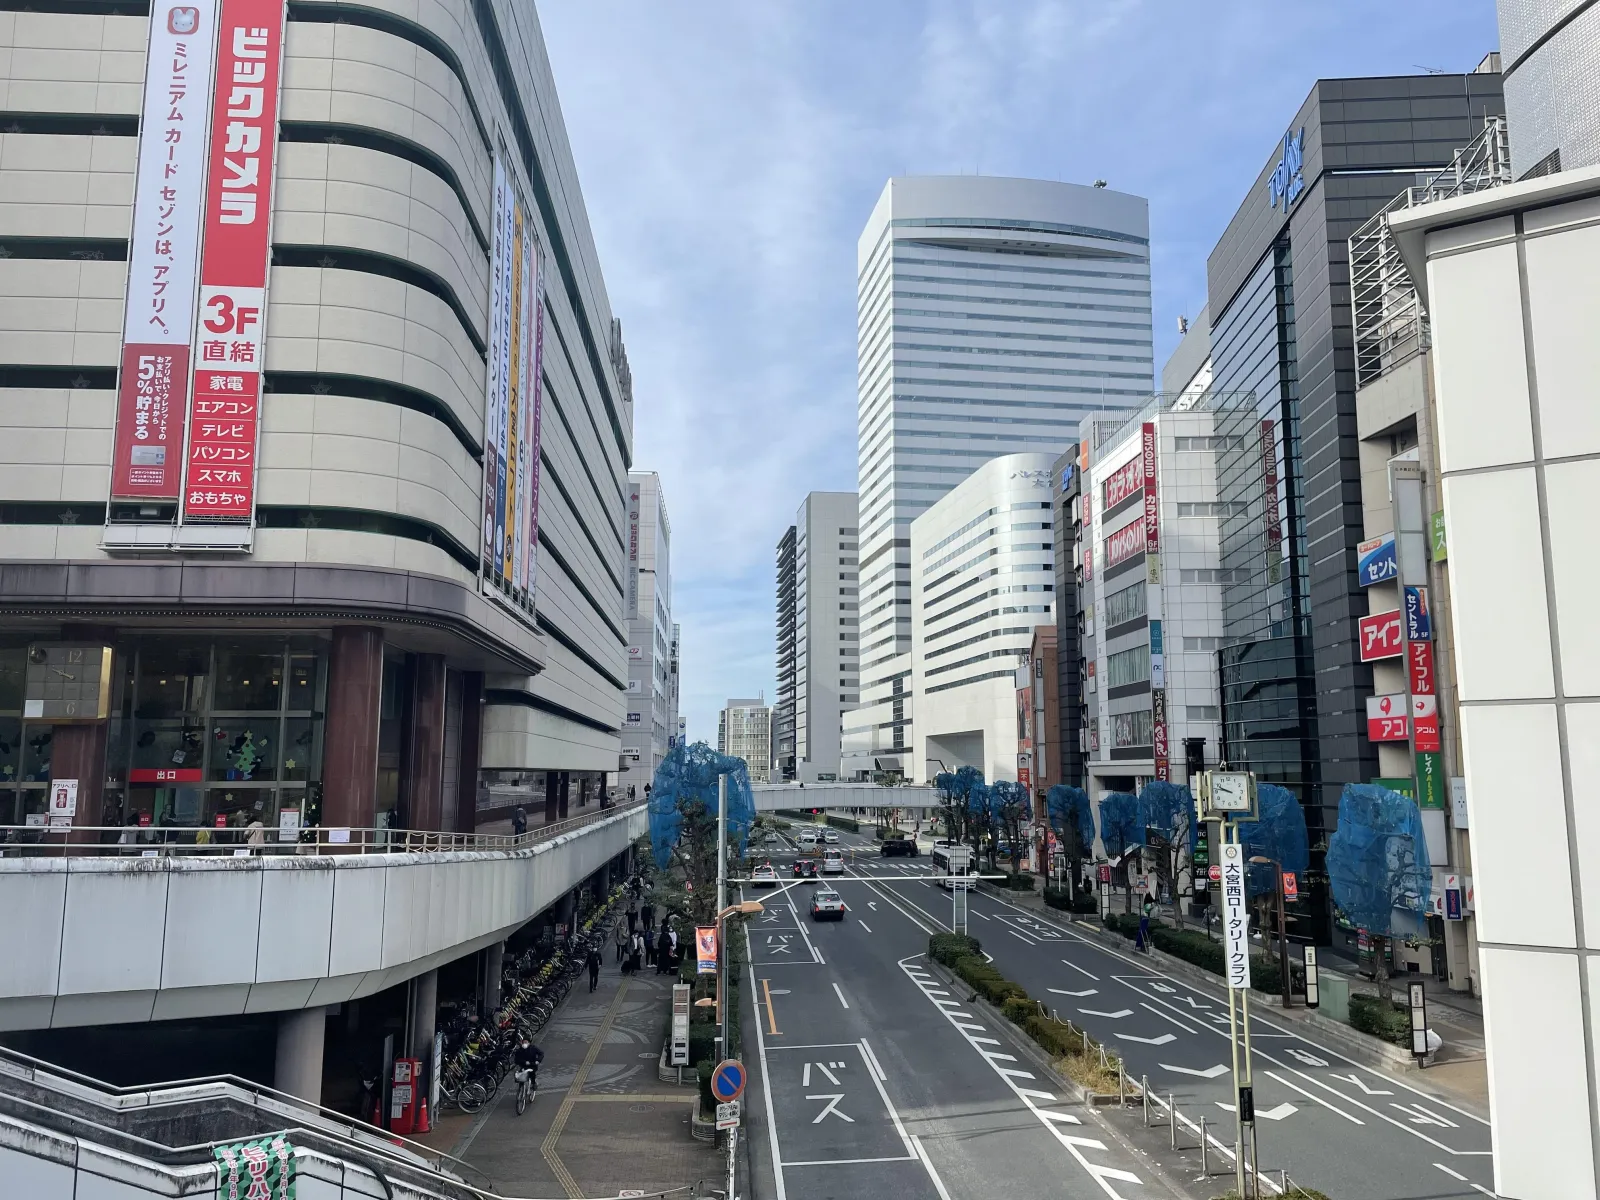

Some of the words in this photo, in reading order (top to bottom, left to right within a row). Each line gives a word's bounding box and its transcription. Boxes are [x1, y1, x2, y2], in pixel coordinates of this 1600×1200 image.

[166, 42, 188, 122] ミレニアム
[219, 27, 269, 225] ビックカメラ
[163, 128, 182, 180] カード
[203, 294, 259, 335] 3F
[203, 340, 255, 363] 直結
[152, 356, 164, 425] お支払いで、今日から
[209, 375, 244, 391] 家電
[134, 355, 156, 440] 5%貯まる
[158, 356, 172, 440] アプリ払い・クレジットでの
[197, 401, 254, 415] エアコン
[201, 424, 245, 437] テレビ
[192, 447, 251, 461] パソコン
[1144, 432, 1154, 478] JOYSOUND
[197, 469, 242, 483] スマホ
[189, 491, 247, 505] おもちゃ
[1146, 494, 1157, 534] カラオケ
[1147, 539, 1158, 548] 6F
[1407, 594, 1419, 639] セントラル
[68, 650, 82, 663] 12
[1413, 643, 1430, 693] アイフル
[66, 702, 76, 715] 6
[1381, 719, 1408, 737] アコ
[1416, 726, 1436, 734] アコム
[156, 770, 176, 780] 出口
[1224, 862, 1246, 985] 大宮西ロータリークラブ
[766, 935, 794, 954] バス
[801, 1061, 855, 1124] バス
